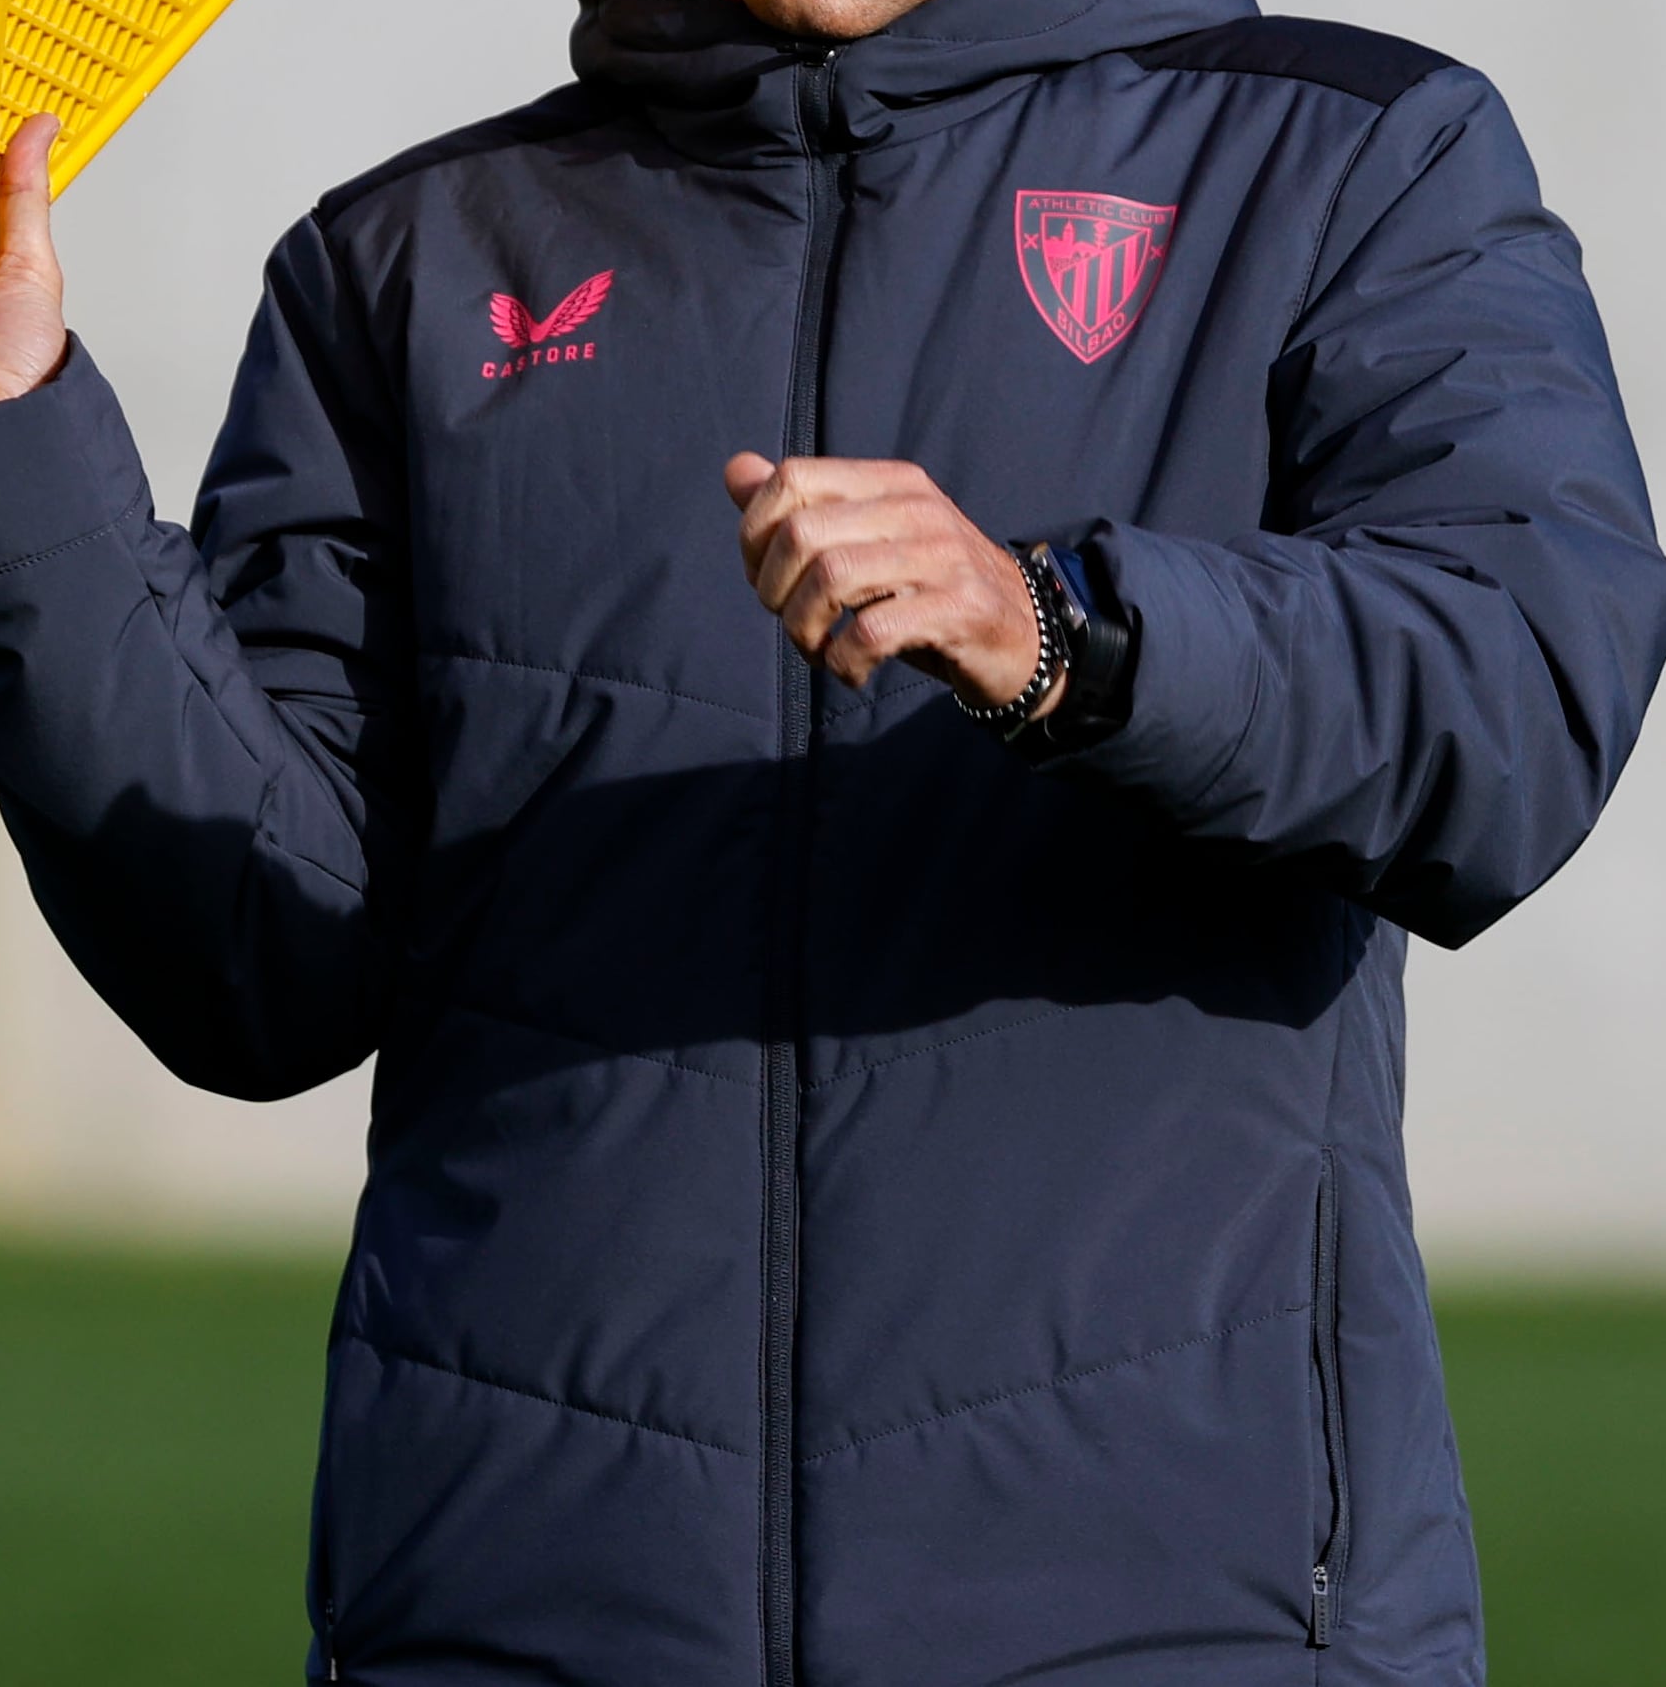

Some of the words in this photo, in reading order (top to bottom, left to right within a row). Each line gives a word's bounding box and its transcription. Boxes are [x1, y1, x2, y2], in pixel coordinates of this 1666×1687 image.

[1029, 198, 1115, 217] ATHLETIC
[1119, 207, 1167, 226] CLUB
[1057, 308, 1126, 353] BILBAO
[481, 342, 594, 379] CASTORE
